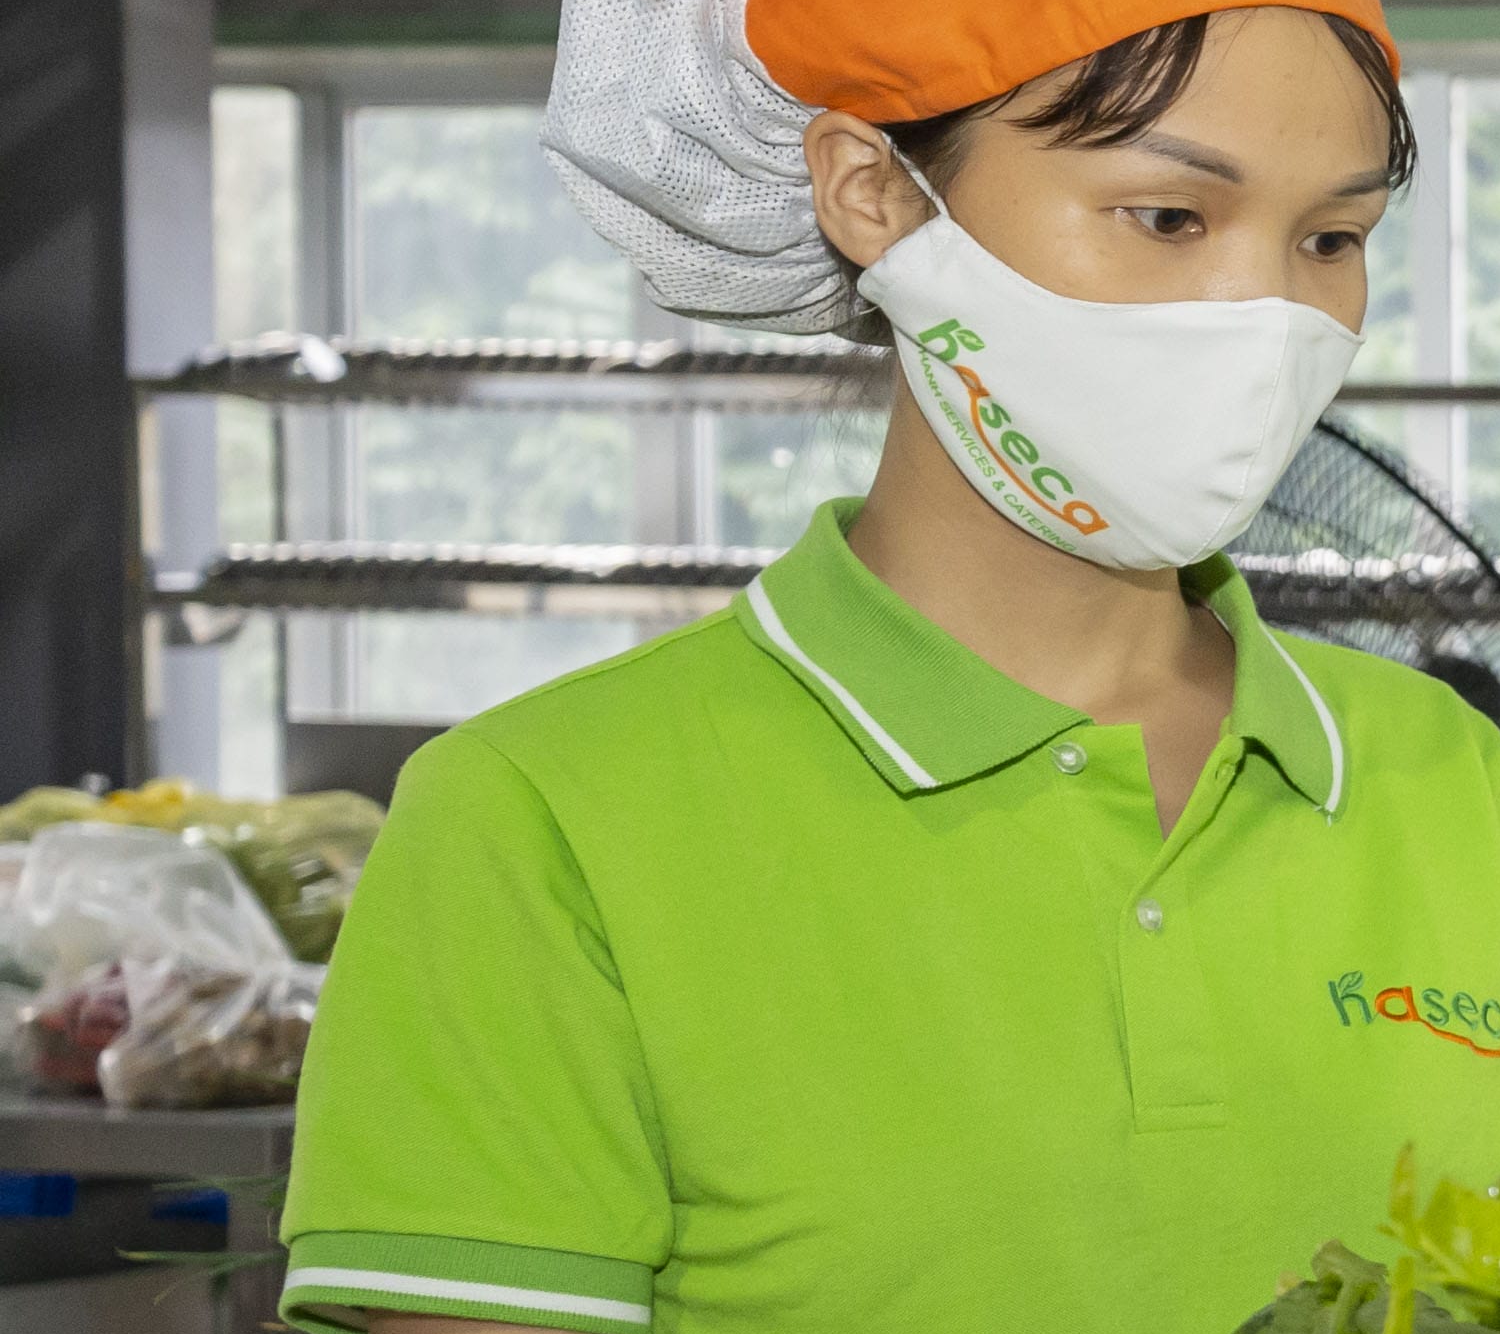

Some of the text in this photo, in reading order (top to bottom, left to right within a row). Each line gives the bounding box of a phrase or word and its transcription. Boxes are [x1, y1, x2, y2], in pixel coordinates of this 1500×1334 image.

[940, 400, 996, 478] SERVICES
[992, 479, 1006, 491] &
[1004, 493, 1077, 552] CATERING
